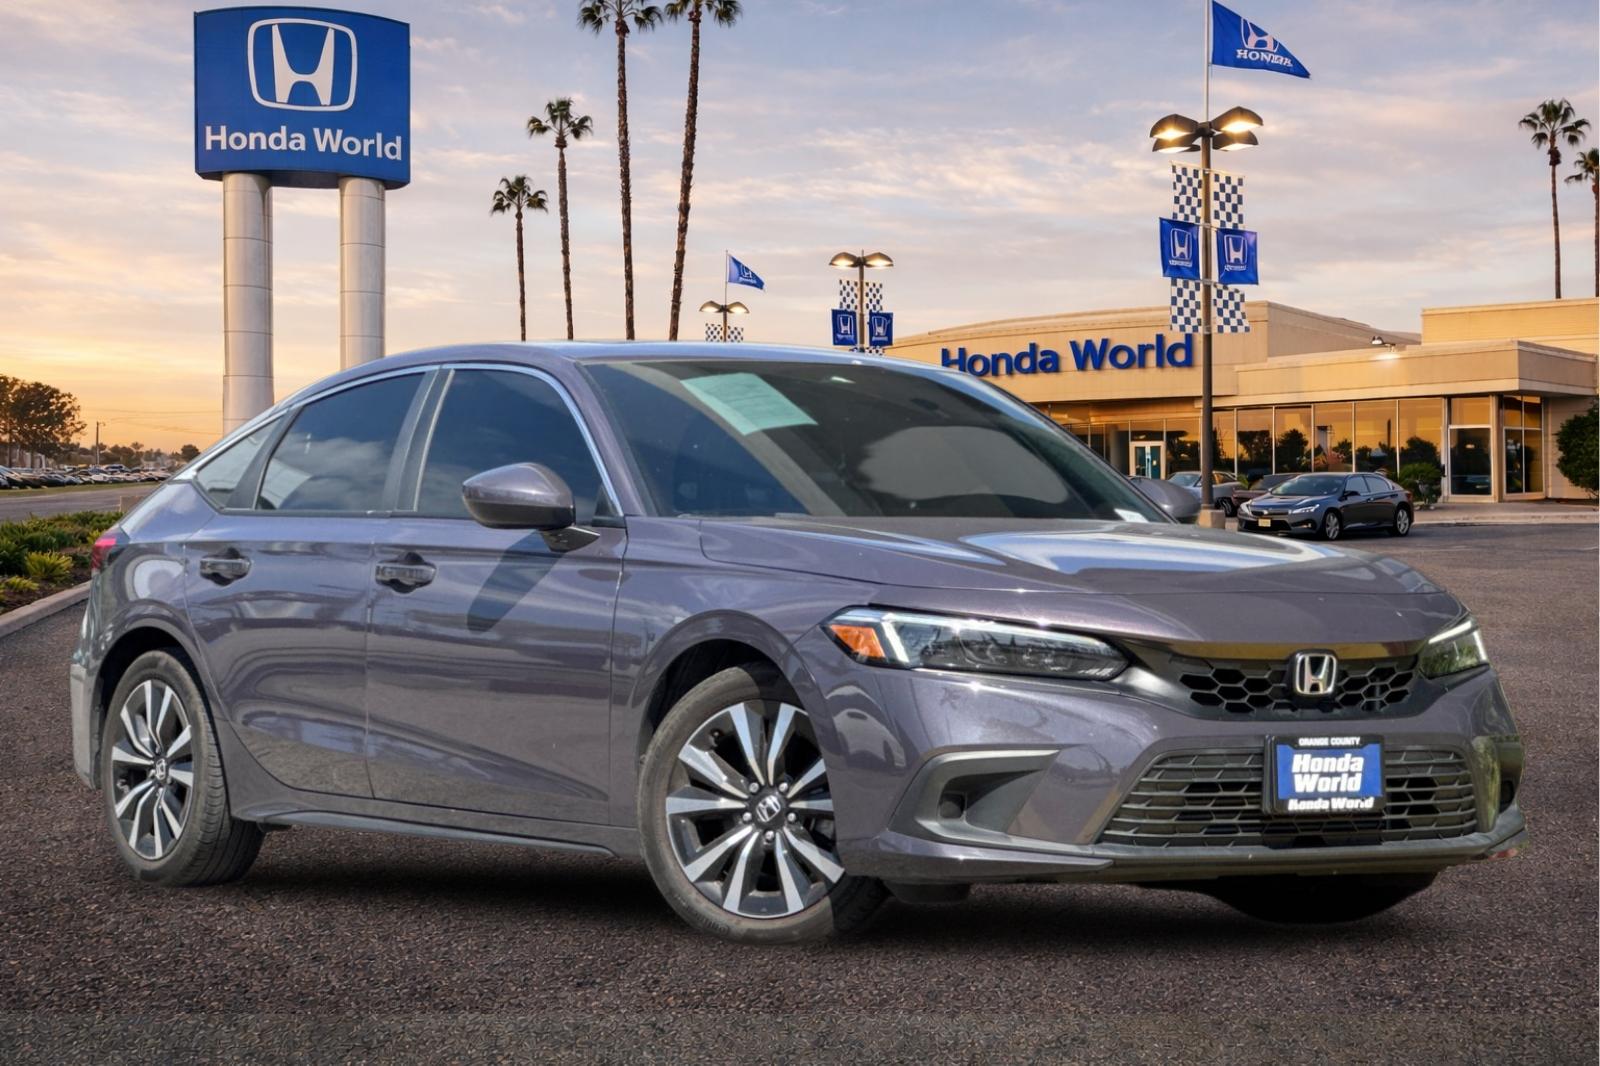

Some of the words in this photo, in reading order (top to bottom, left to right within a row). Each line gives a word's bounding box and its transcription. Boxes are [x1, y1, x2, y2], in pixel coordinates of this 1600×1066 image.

[205, 125, 306, 151] Honda
[313, 127, 402, 161] World
[941, 342, 1060, 377] Honda
[1070, 333, 1194, 371] World
[1298, 737, 1329, 746] ORANGE
[1330, 736, 1360, 746] COUNTY
[1292, 753, 1364, 773] Honda
[1294, 772, 1362, 793] World
[1288, 798, 1330, 811] Honda
[1330, 796, 1375, 809] World
